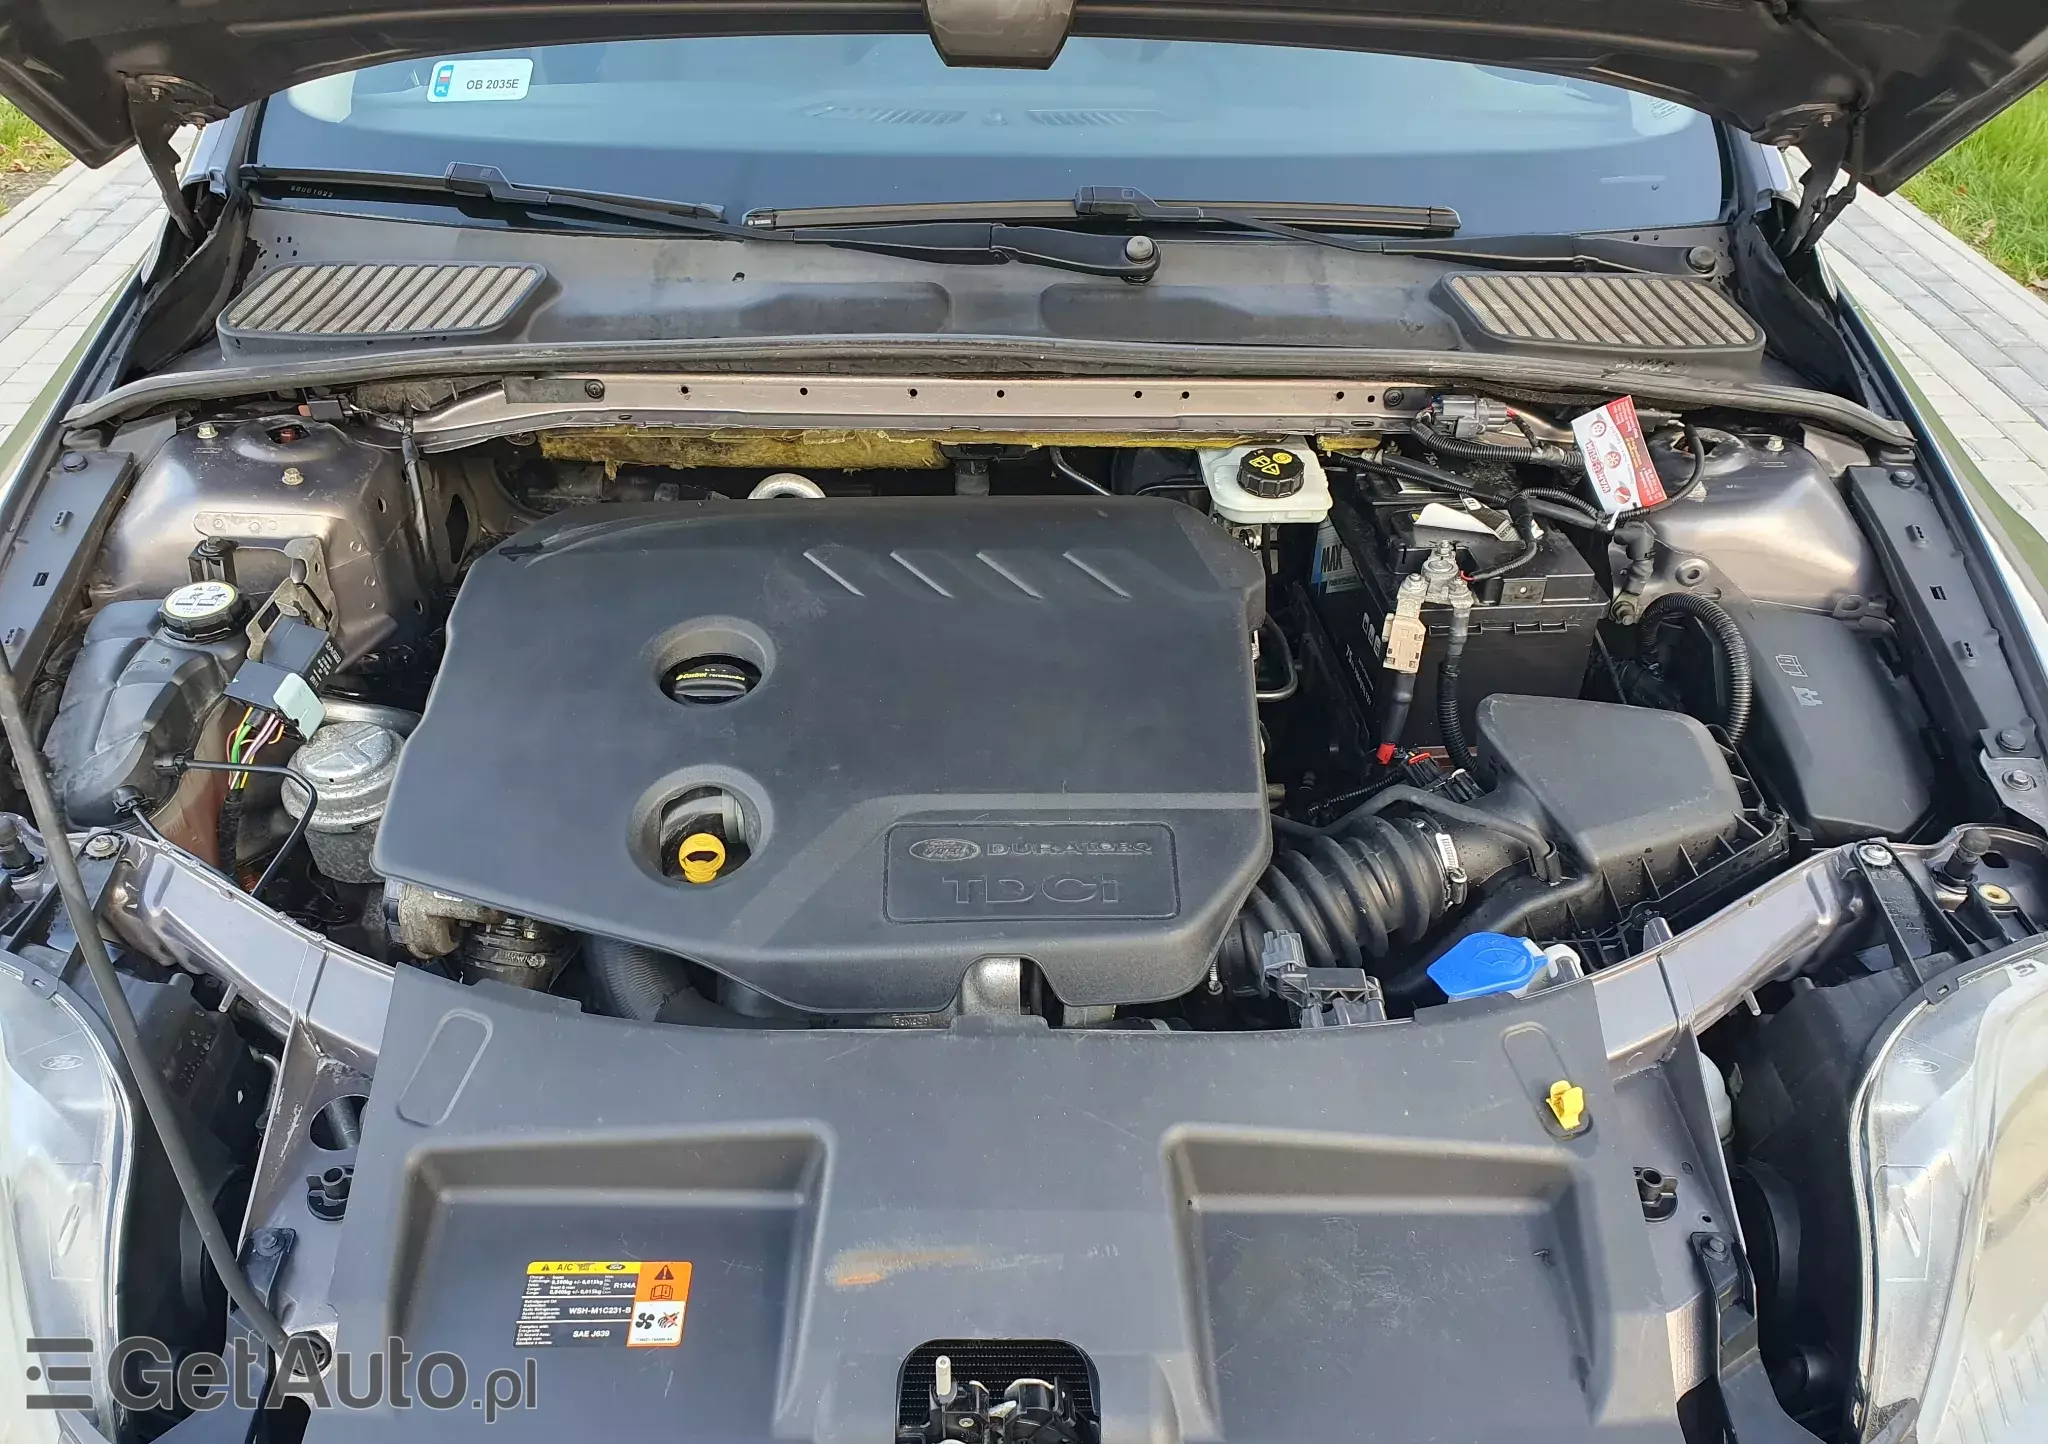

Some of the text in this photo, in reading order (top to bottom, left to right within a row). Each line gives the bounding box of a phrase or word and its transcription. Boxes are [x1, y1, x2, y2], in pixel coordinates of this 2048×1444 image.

[466, 79, 520, 90] OB 2035E
[1321, 543, 1343, 573] MAX
[988, 842, 1153, 856] DURATORQ
[942, 875, 1120, 905] TDCi
[568, 1306, 632, 1315] WSH-M1C231-B
[572, 1330, 611, 1338] SAE J639
